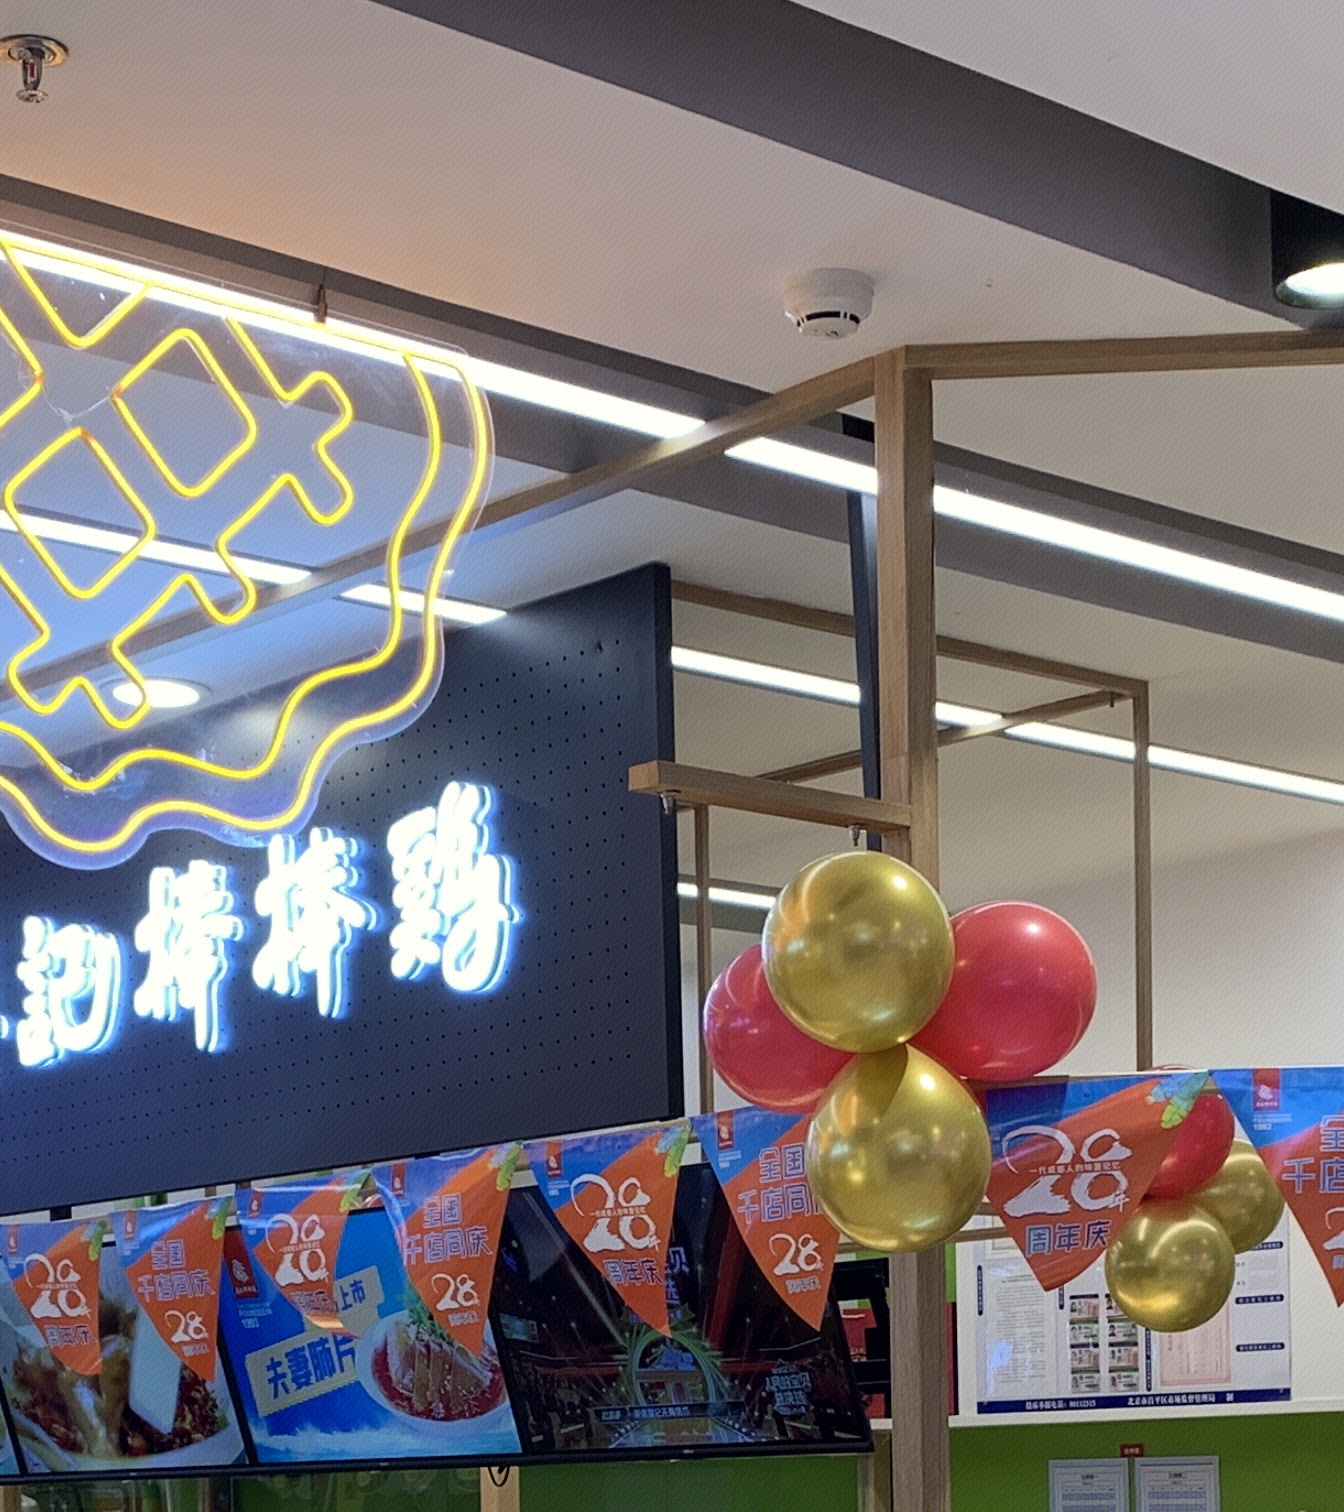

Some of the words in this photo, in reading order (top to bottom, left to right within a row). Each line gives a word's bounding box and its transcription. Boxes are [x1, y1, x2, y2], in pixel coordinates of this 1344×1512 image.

[758, 1143, 806, 1184] 全国
[422, 1193, 463, 1229] 全国
[736, 1183, 823, 1225] 千店同
[404, 1225, 494, 1265] 千店同庆
[1025, 1219, 1112, 1258] 周年庆
[603, 1258, 666, 1286] 周年庆
[264, 1331, 356, 1400] 夫妻肺片
